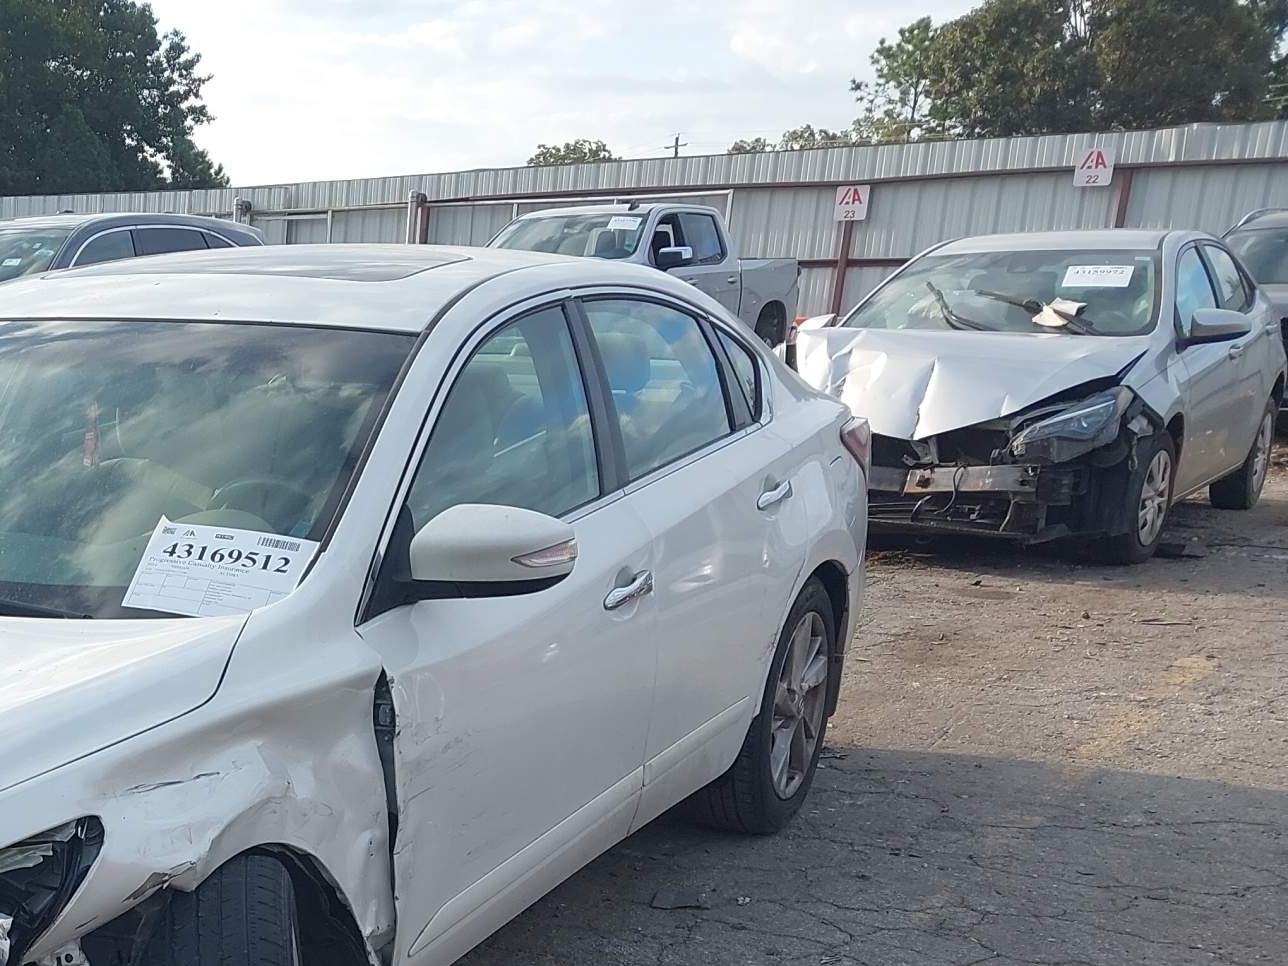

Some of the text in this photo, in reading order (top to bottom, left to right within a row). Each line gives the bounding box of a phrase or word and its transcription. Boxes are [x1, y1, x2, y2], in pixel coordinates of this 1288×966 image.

[1085, 174, 1099, 184] 22
[843, 209, 856, 219] 23
[163, 542, 291, 574] 43169512
[188, 560, 217, 570] Casualty
[217, 564, 250, 574] Insurance
